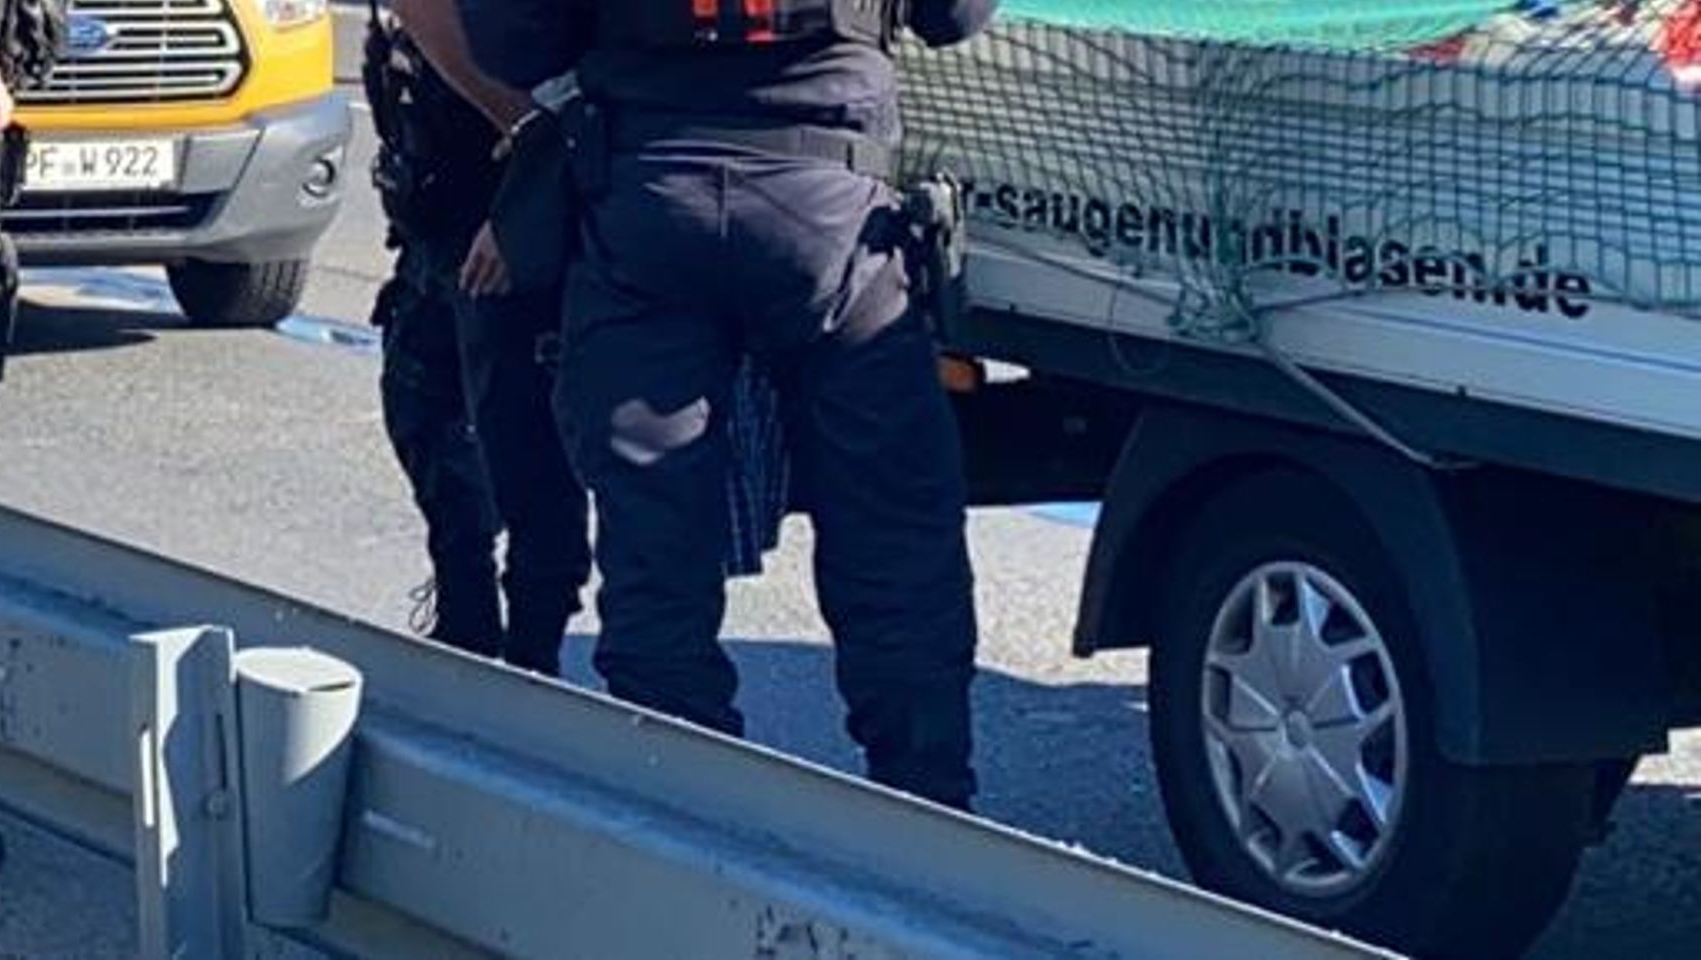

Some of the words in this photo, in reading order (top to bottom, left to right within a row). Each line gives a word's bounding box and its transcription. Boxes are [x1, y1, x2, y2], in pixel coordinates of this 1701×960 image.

[79, 147, 98, 176] W
[106, 146, 158, 176] 922
[959, 178, 1591, 319] r-saugenundblasen.de
